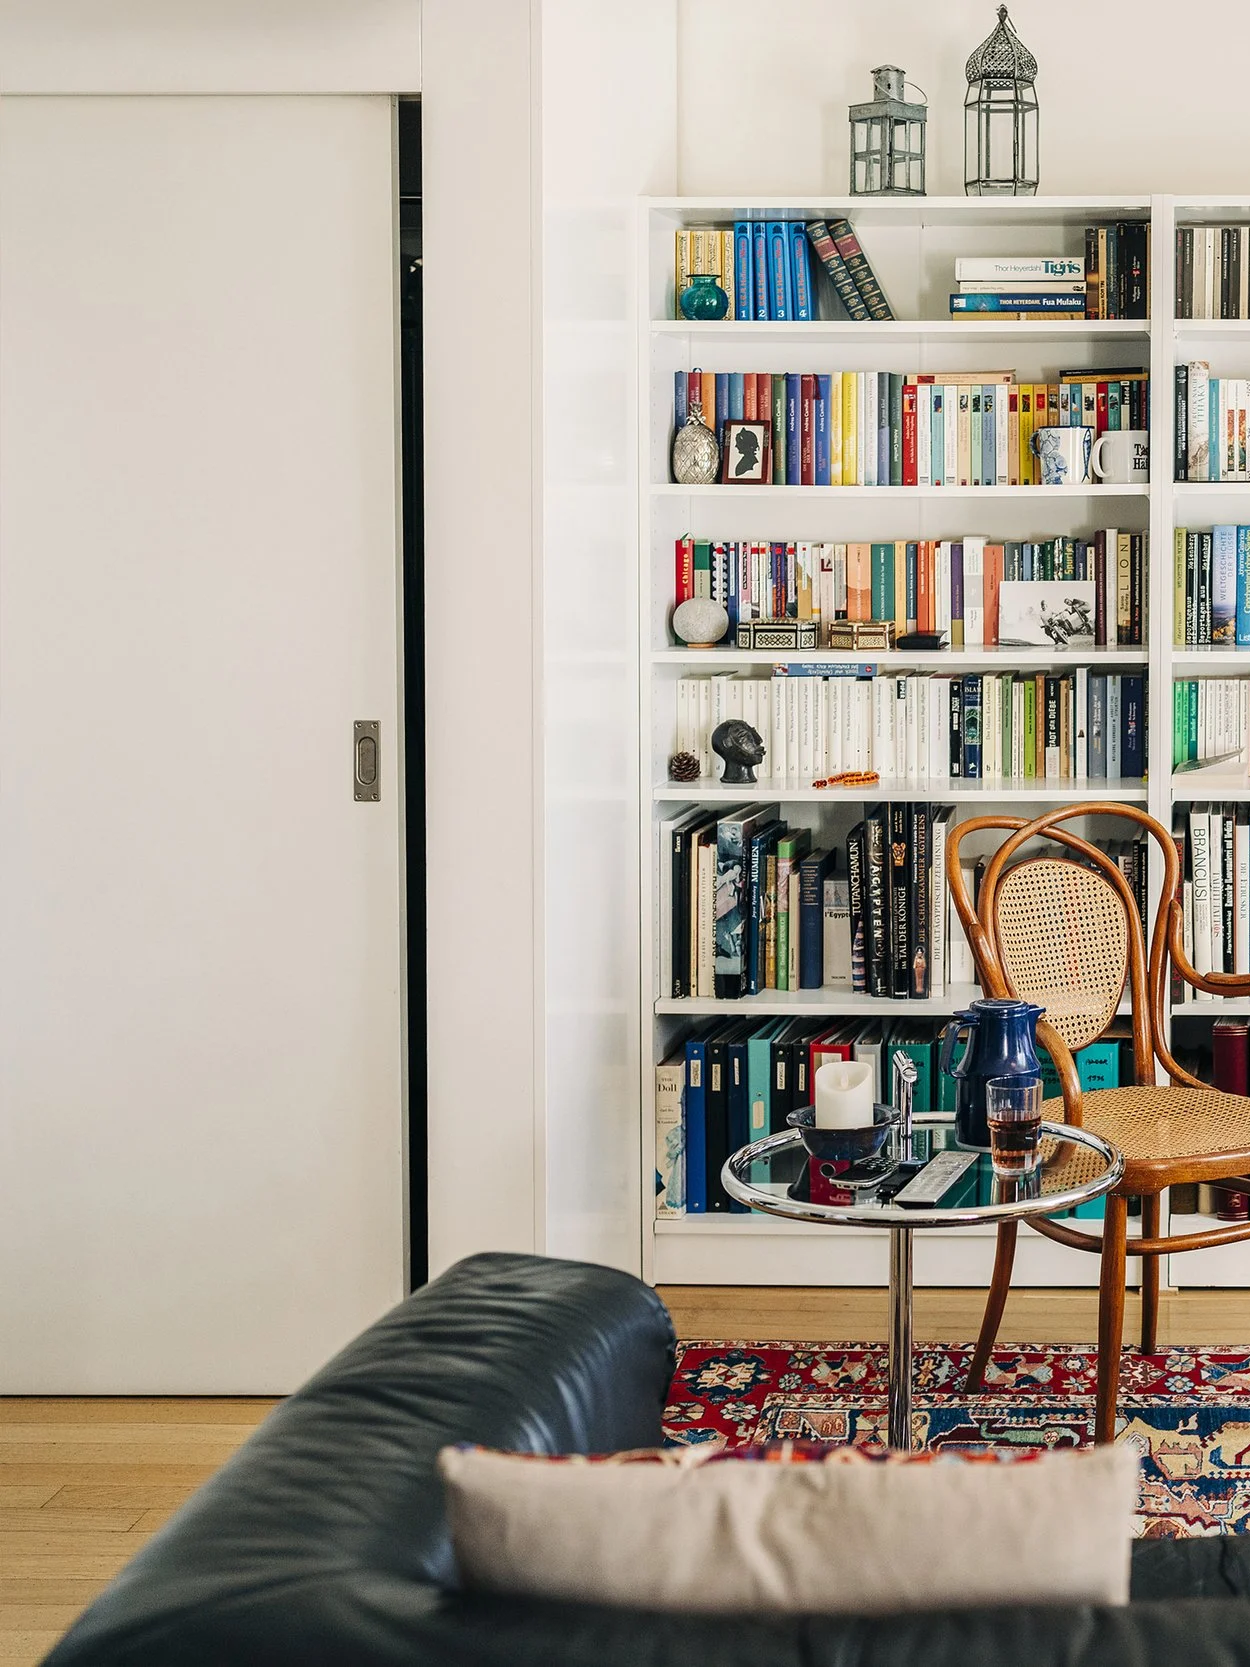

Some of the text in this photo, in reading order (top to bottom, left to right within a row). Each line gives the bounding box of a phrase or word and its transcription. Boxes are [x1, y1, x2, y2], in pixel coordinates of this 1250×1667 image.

[1041, 260, 1081, 277] Tigris
[740, 309, 746, 318] 1
[759, 309, 766, 318] 2
[778, 309, 785, 318] 3
[799, 309, 807, 318] 4
[1120, 544, 1129, 591] LION
[751, 845, 759, 883] MUMIEN
[850, 841, 861, 916] TUTANCHAMUN
[918, 814, 926, 943] DIE SCHATZKAMMER ÄGYPTENS
[1194, 829, 1207, 902] BRANCUSI
[1225, 820, 1233, 907] Russische und Medizin
[872, 866, 882, 939] ÄGYPTEN
[933, 828, 942, 960] DIE ALTÄGYPTISCHE ZEICHNUNG
[1240, 862, 1248, 919] DIE ETRUSKER
[897, 886, 907, 969] IM TAL DER KÖNIGE
[658, 1083, 677, 1093] Doll
